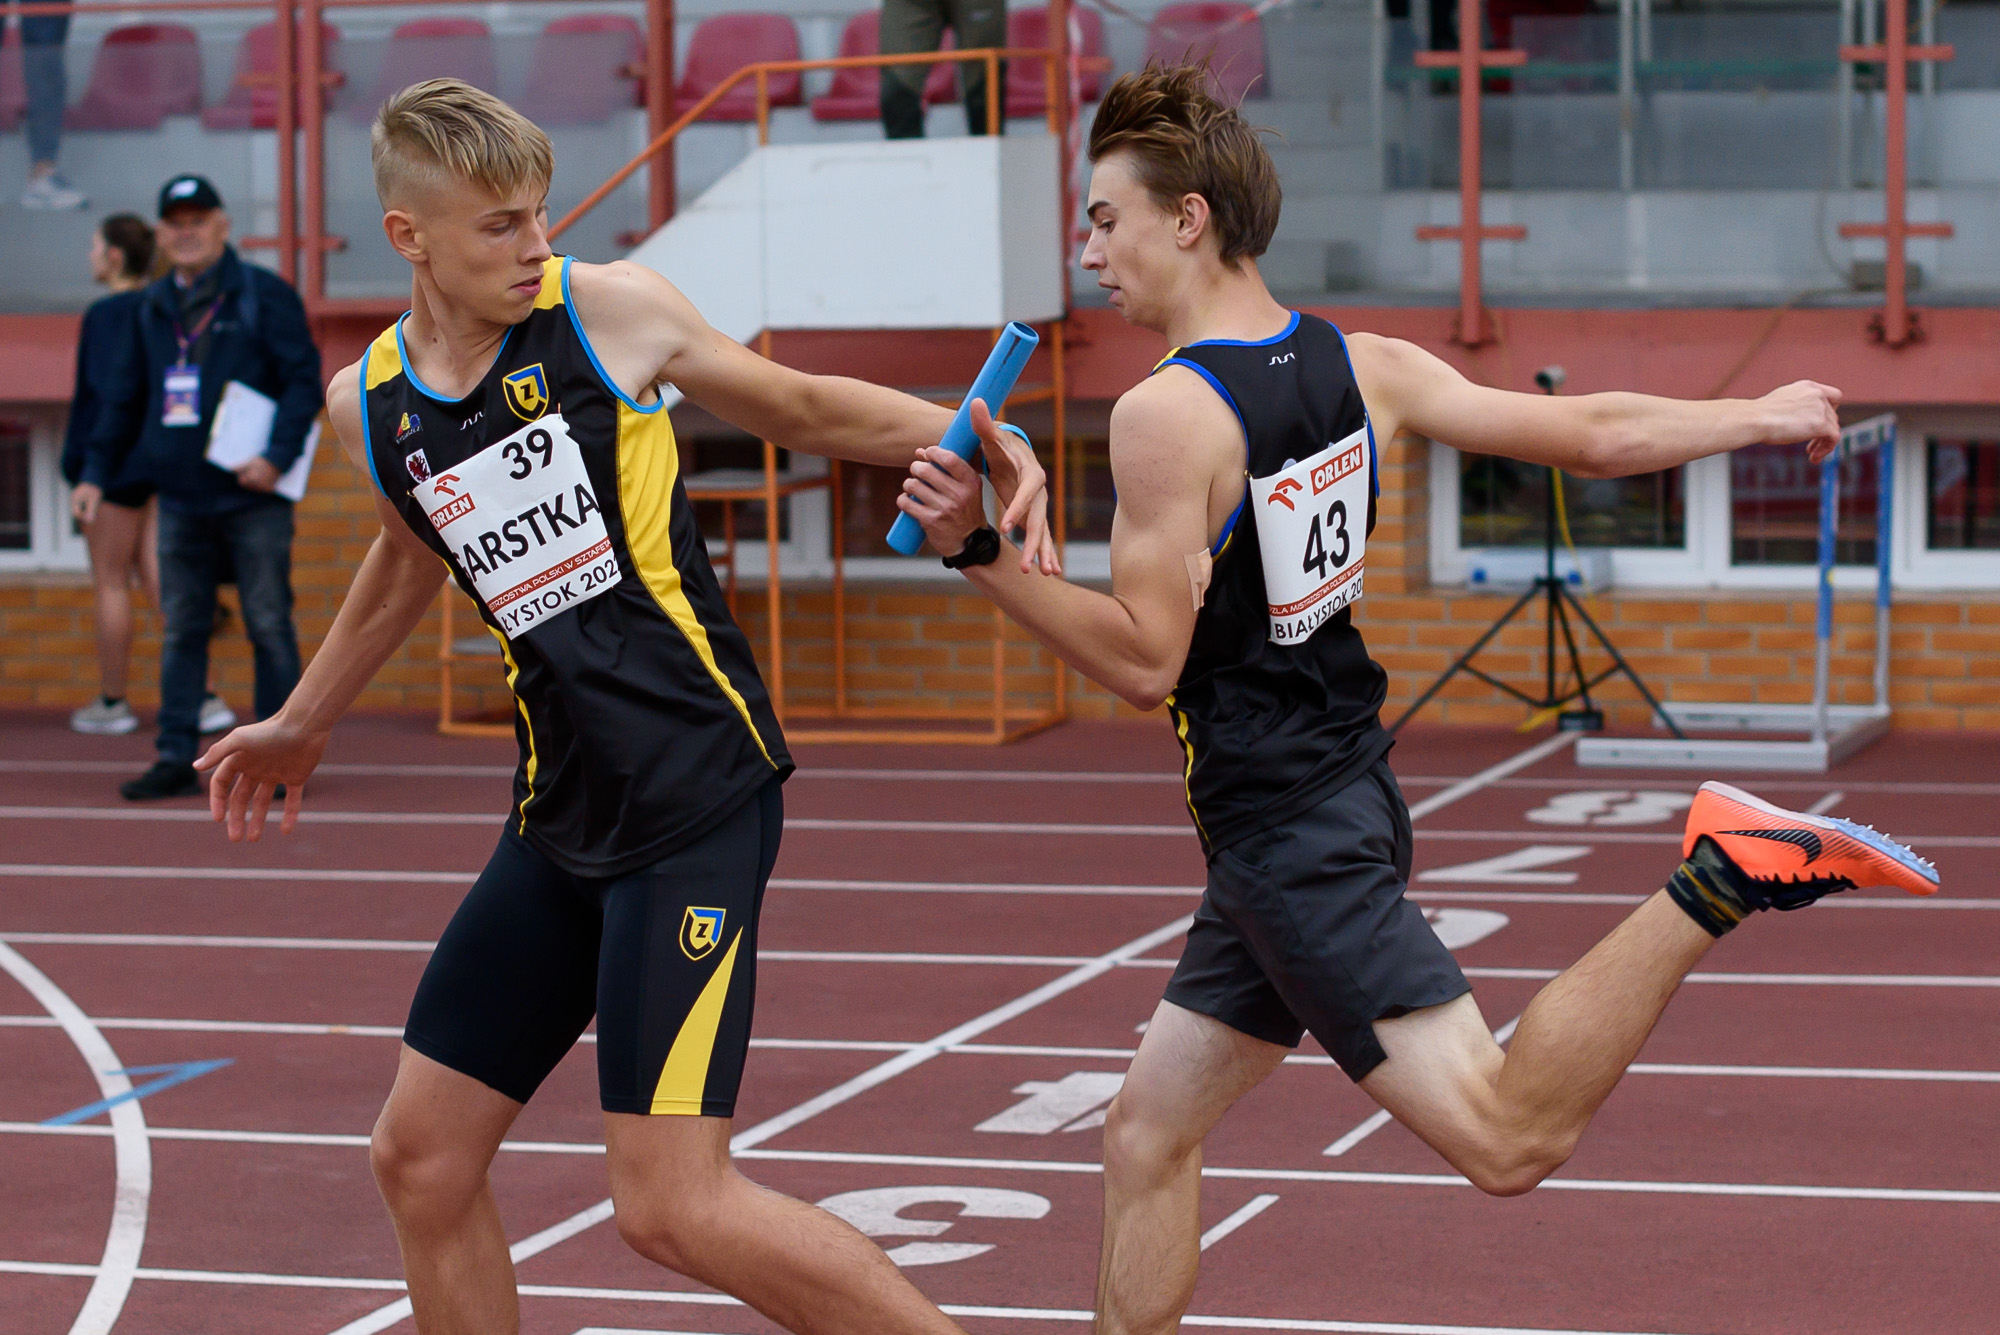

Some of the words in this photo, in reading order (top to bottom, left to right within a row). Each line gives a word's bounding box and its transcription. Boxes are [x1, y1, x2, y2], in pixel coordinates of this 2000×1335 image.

[520, 383, 534, 401] Z
[502, 428, 554, 481] 39
[1314, 447, 1361, 490] ORLEN
[432, 496, 472, 528] ORLEN
[452, 483, 601, 583] ARSTKA
[1302, 500, 1350, 580] 43
[501, 581, 579, 633] ŁYSTOK
[580, 556, 619, 592] 202
[532, 567, 564, 587] POLSKI
[564, 560, 574, 569] W
[1274, 588, 1348, 639] BIAŁYSTOK
[695, 922, 710, 939] Z
